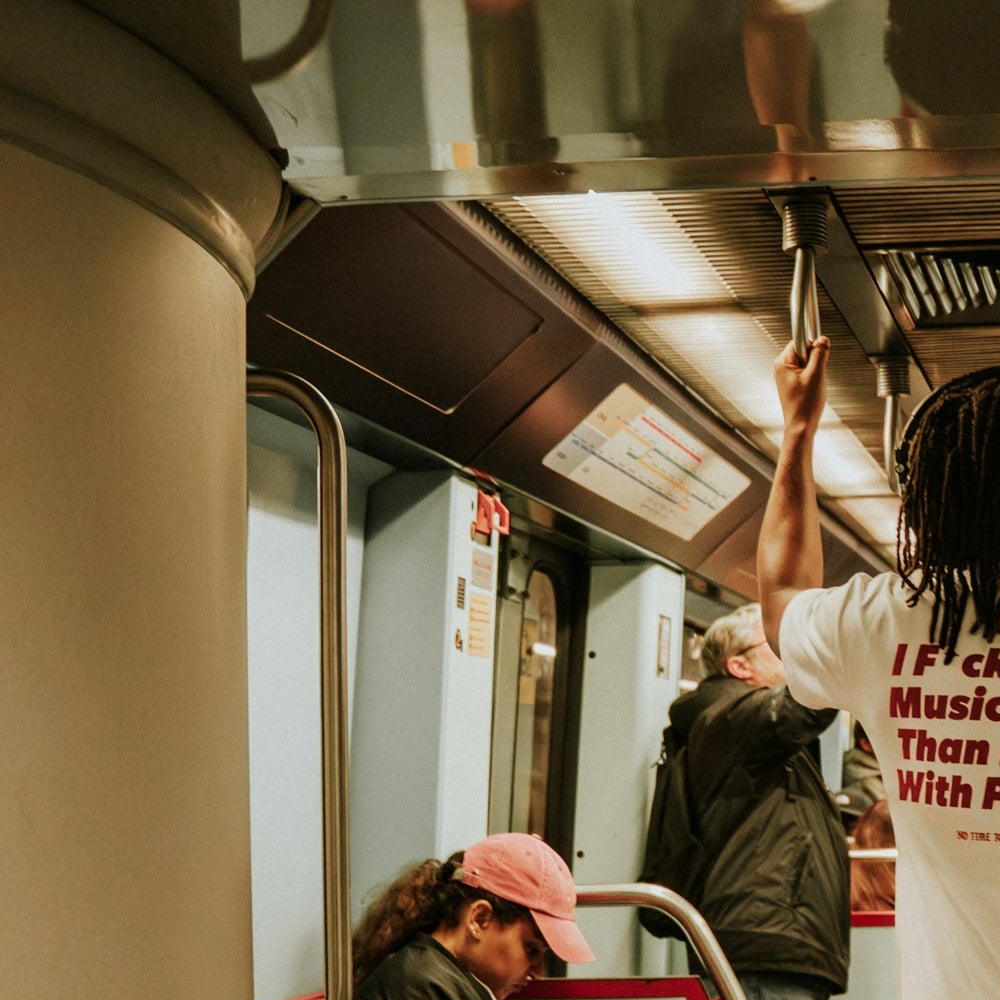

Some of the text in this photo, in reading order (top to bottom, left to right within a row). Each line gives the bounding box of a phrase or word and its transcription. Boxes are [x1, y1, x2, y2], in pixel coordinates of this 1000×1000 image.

[891, 643, 908, 676] I
[897, 728, 990, 766] Than
[896, 768, 973, 809] With
